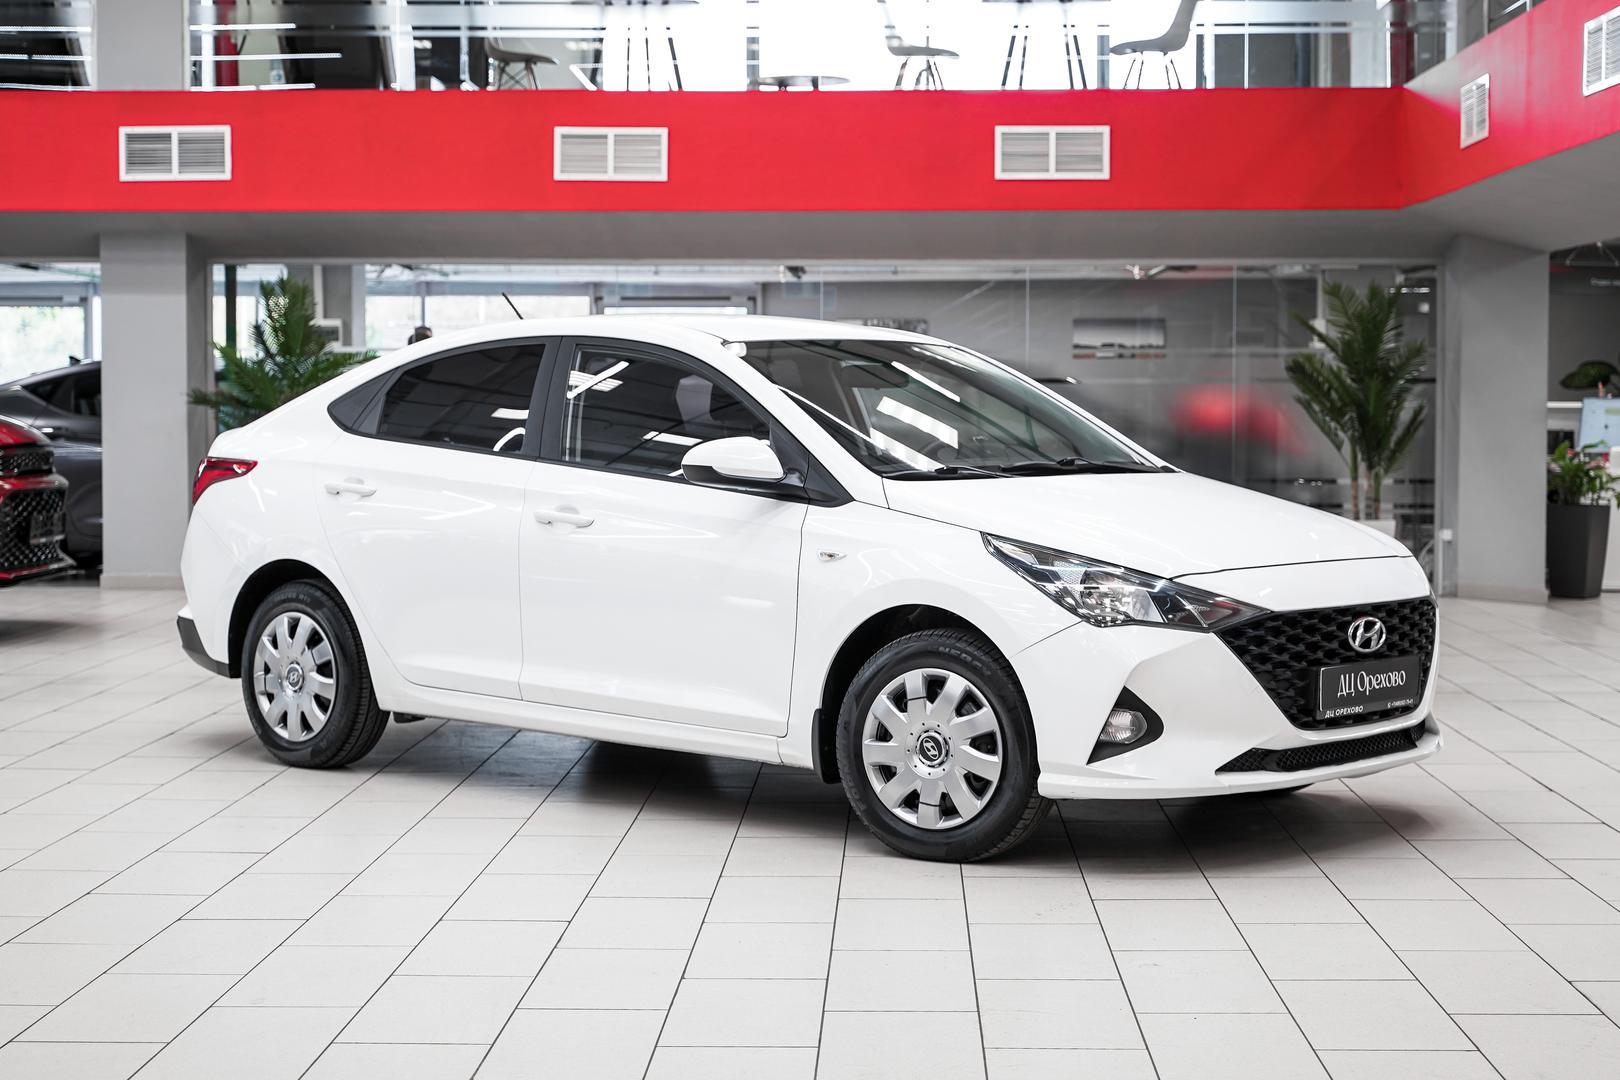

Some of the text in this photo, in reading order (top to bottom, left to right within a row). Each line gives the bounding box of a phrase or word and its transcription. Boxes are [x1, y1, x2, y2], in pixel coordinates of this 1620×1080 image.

[1337, 670, 1406, 698] ДЦ Орехово
[1324, 705, 1364, 719] ДЦ ОРЕХОВО
